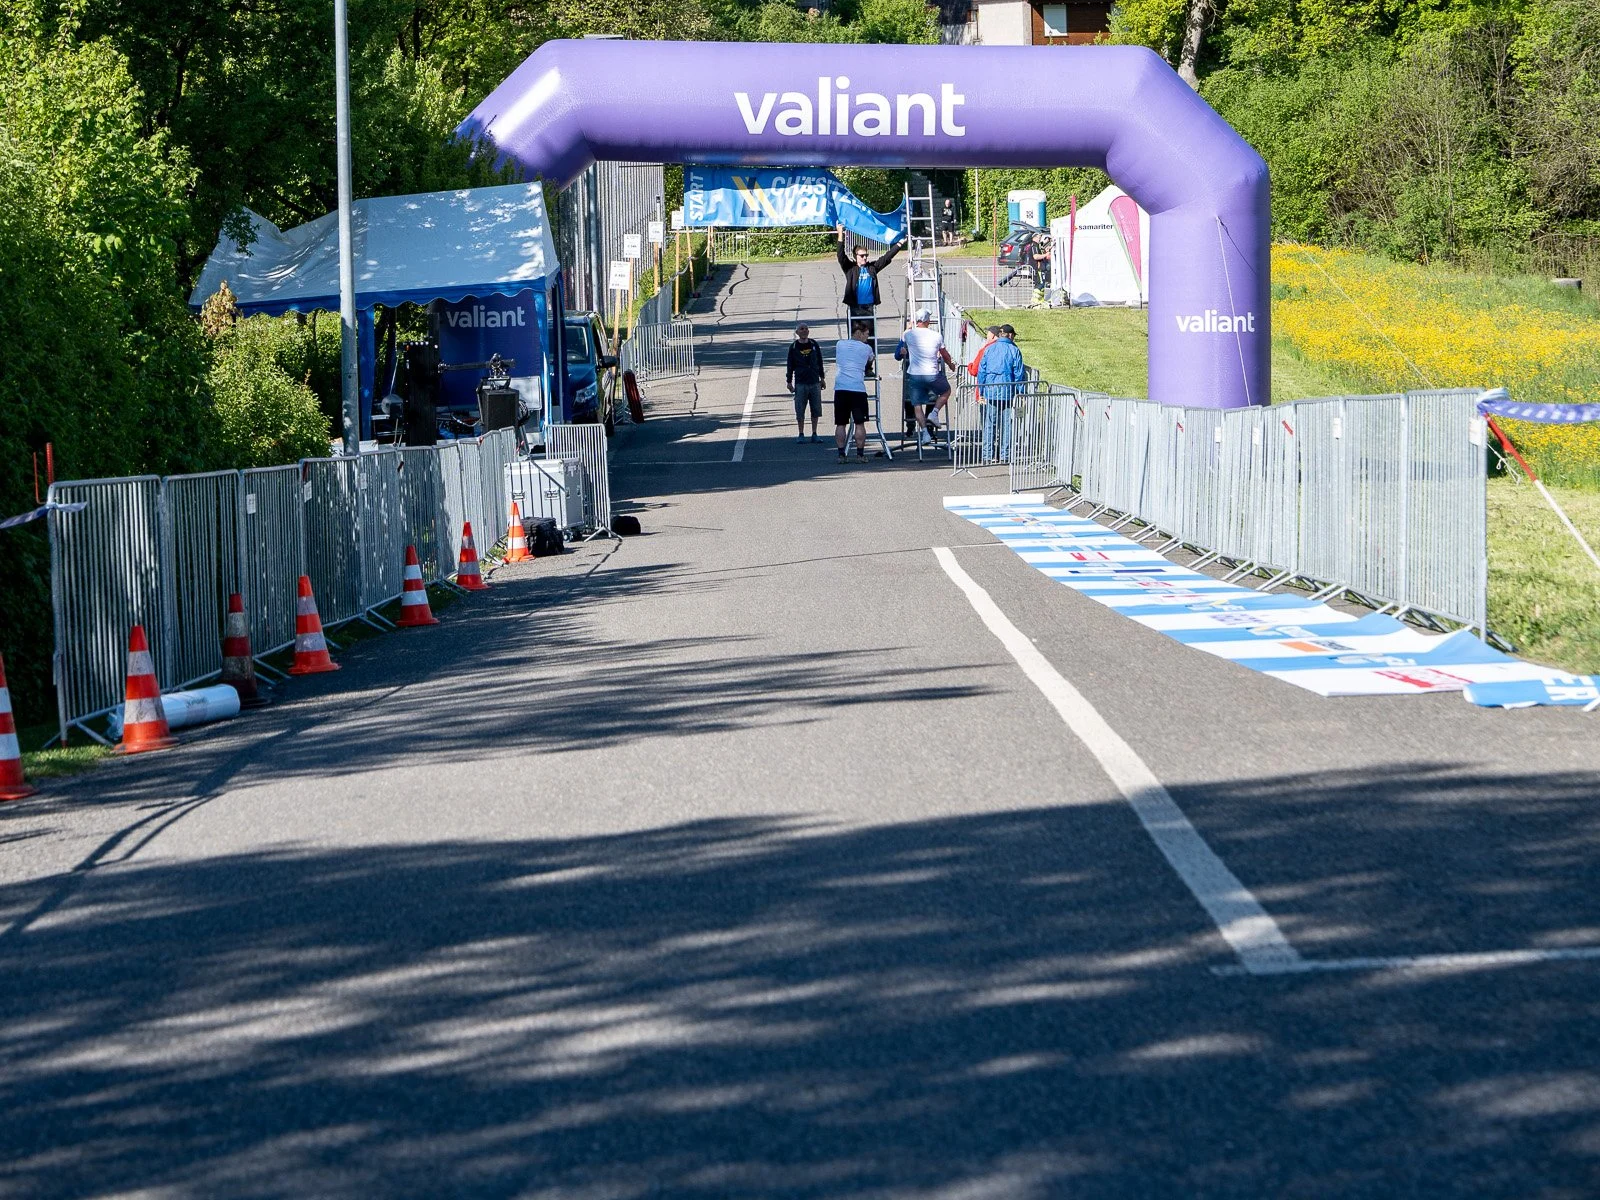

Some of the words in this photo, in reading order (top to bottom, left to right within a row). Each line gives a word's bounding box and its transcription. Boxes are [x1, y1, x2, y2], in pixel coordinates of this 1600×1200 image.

[734, 76, 966, 137] valiant
[690, 172, 704, 221] START
[1078, 223, 1114, 231] samariter
[446, 305, 526, 328] valiant
[1175, 309, 1255, 333] valiant
